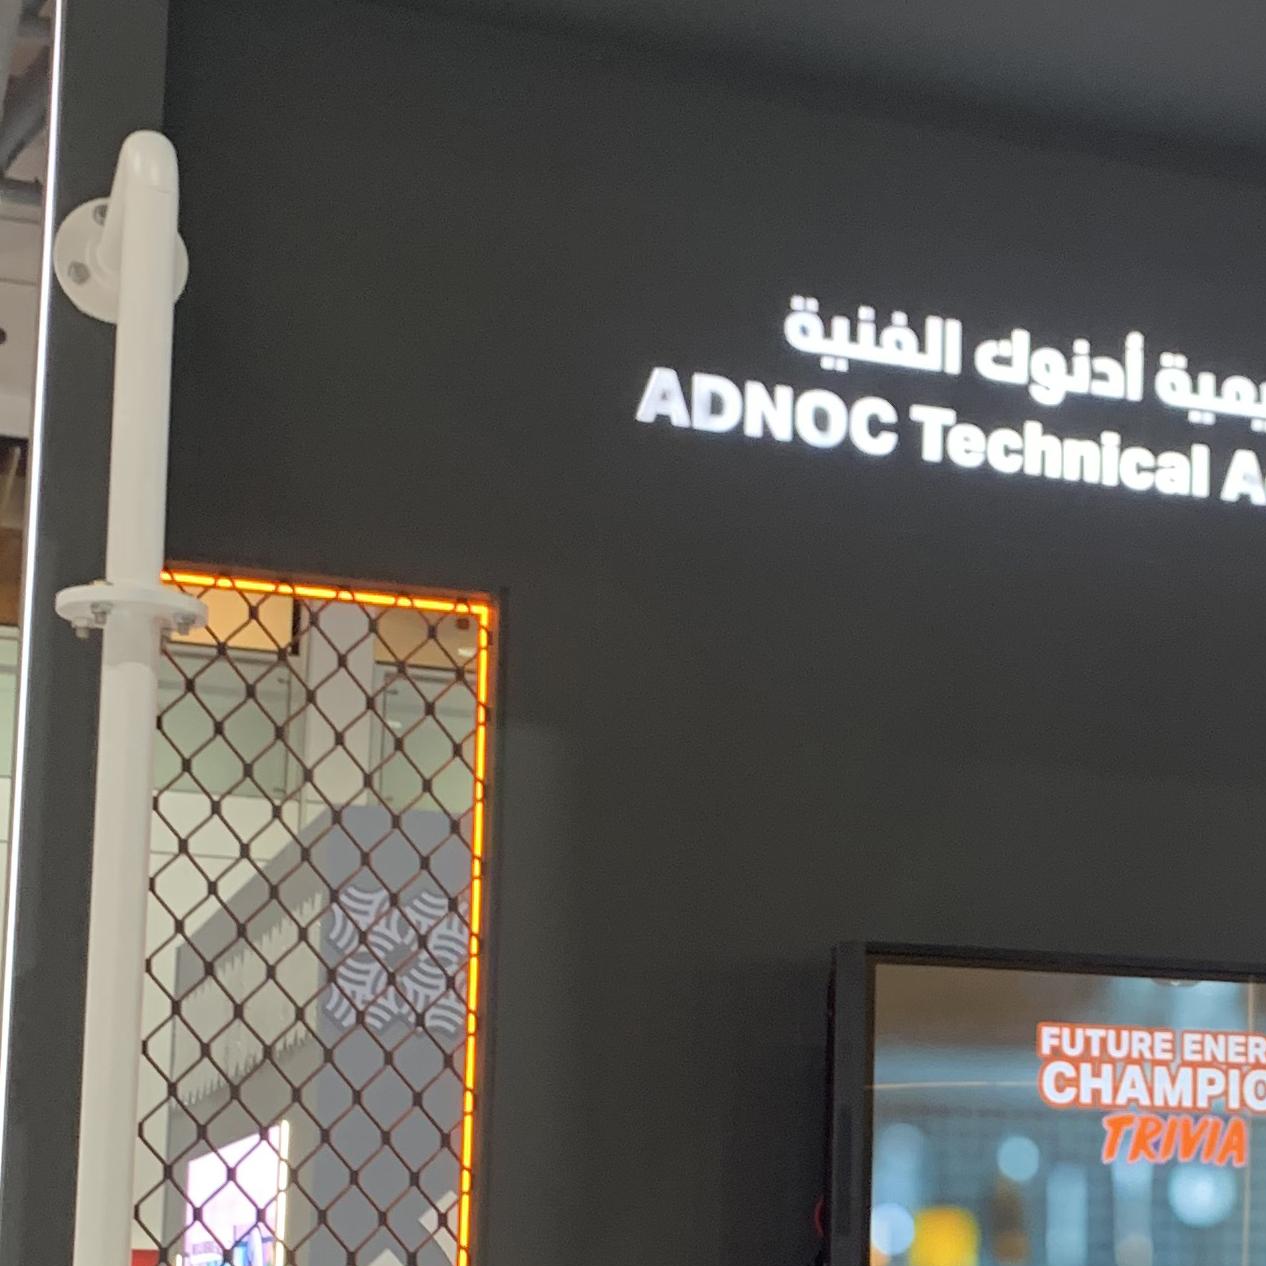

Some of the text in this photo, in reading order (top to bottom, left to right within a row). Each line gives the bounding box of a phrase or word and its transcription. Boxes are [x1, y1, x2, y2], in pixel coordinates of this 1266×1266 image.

[784, 295, 962, 375] الفنية
[974, 328, 1144, 406] أدنوك
[635, 366, 898, 457] ADNOC
[910, 404, 1210, 498] Technical
[1040, 1026, 1174, 1060] FUTURE
[1102, 1113, 1249, 1167] TRIVIA
